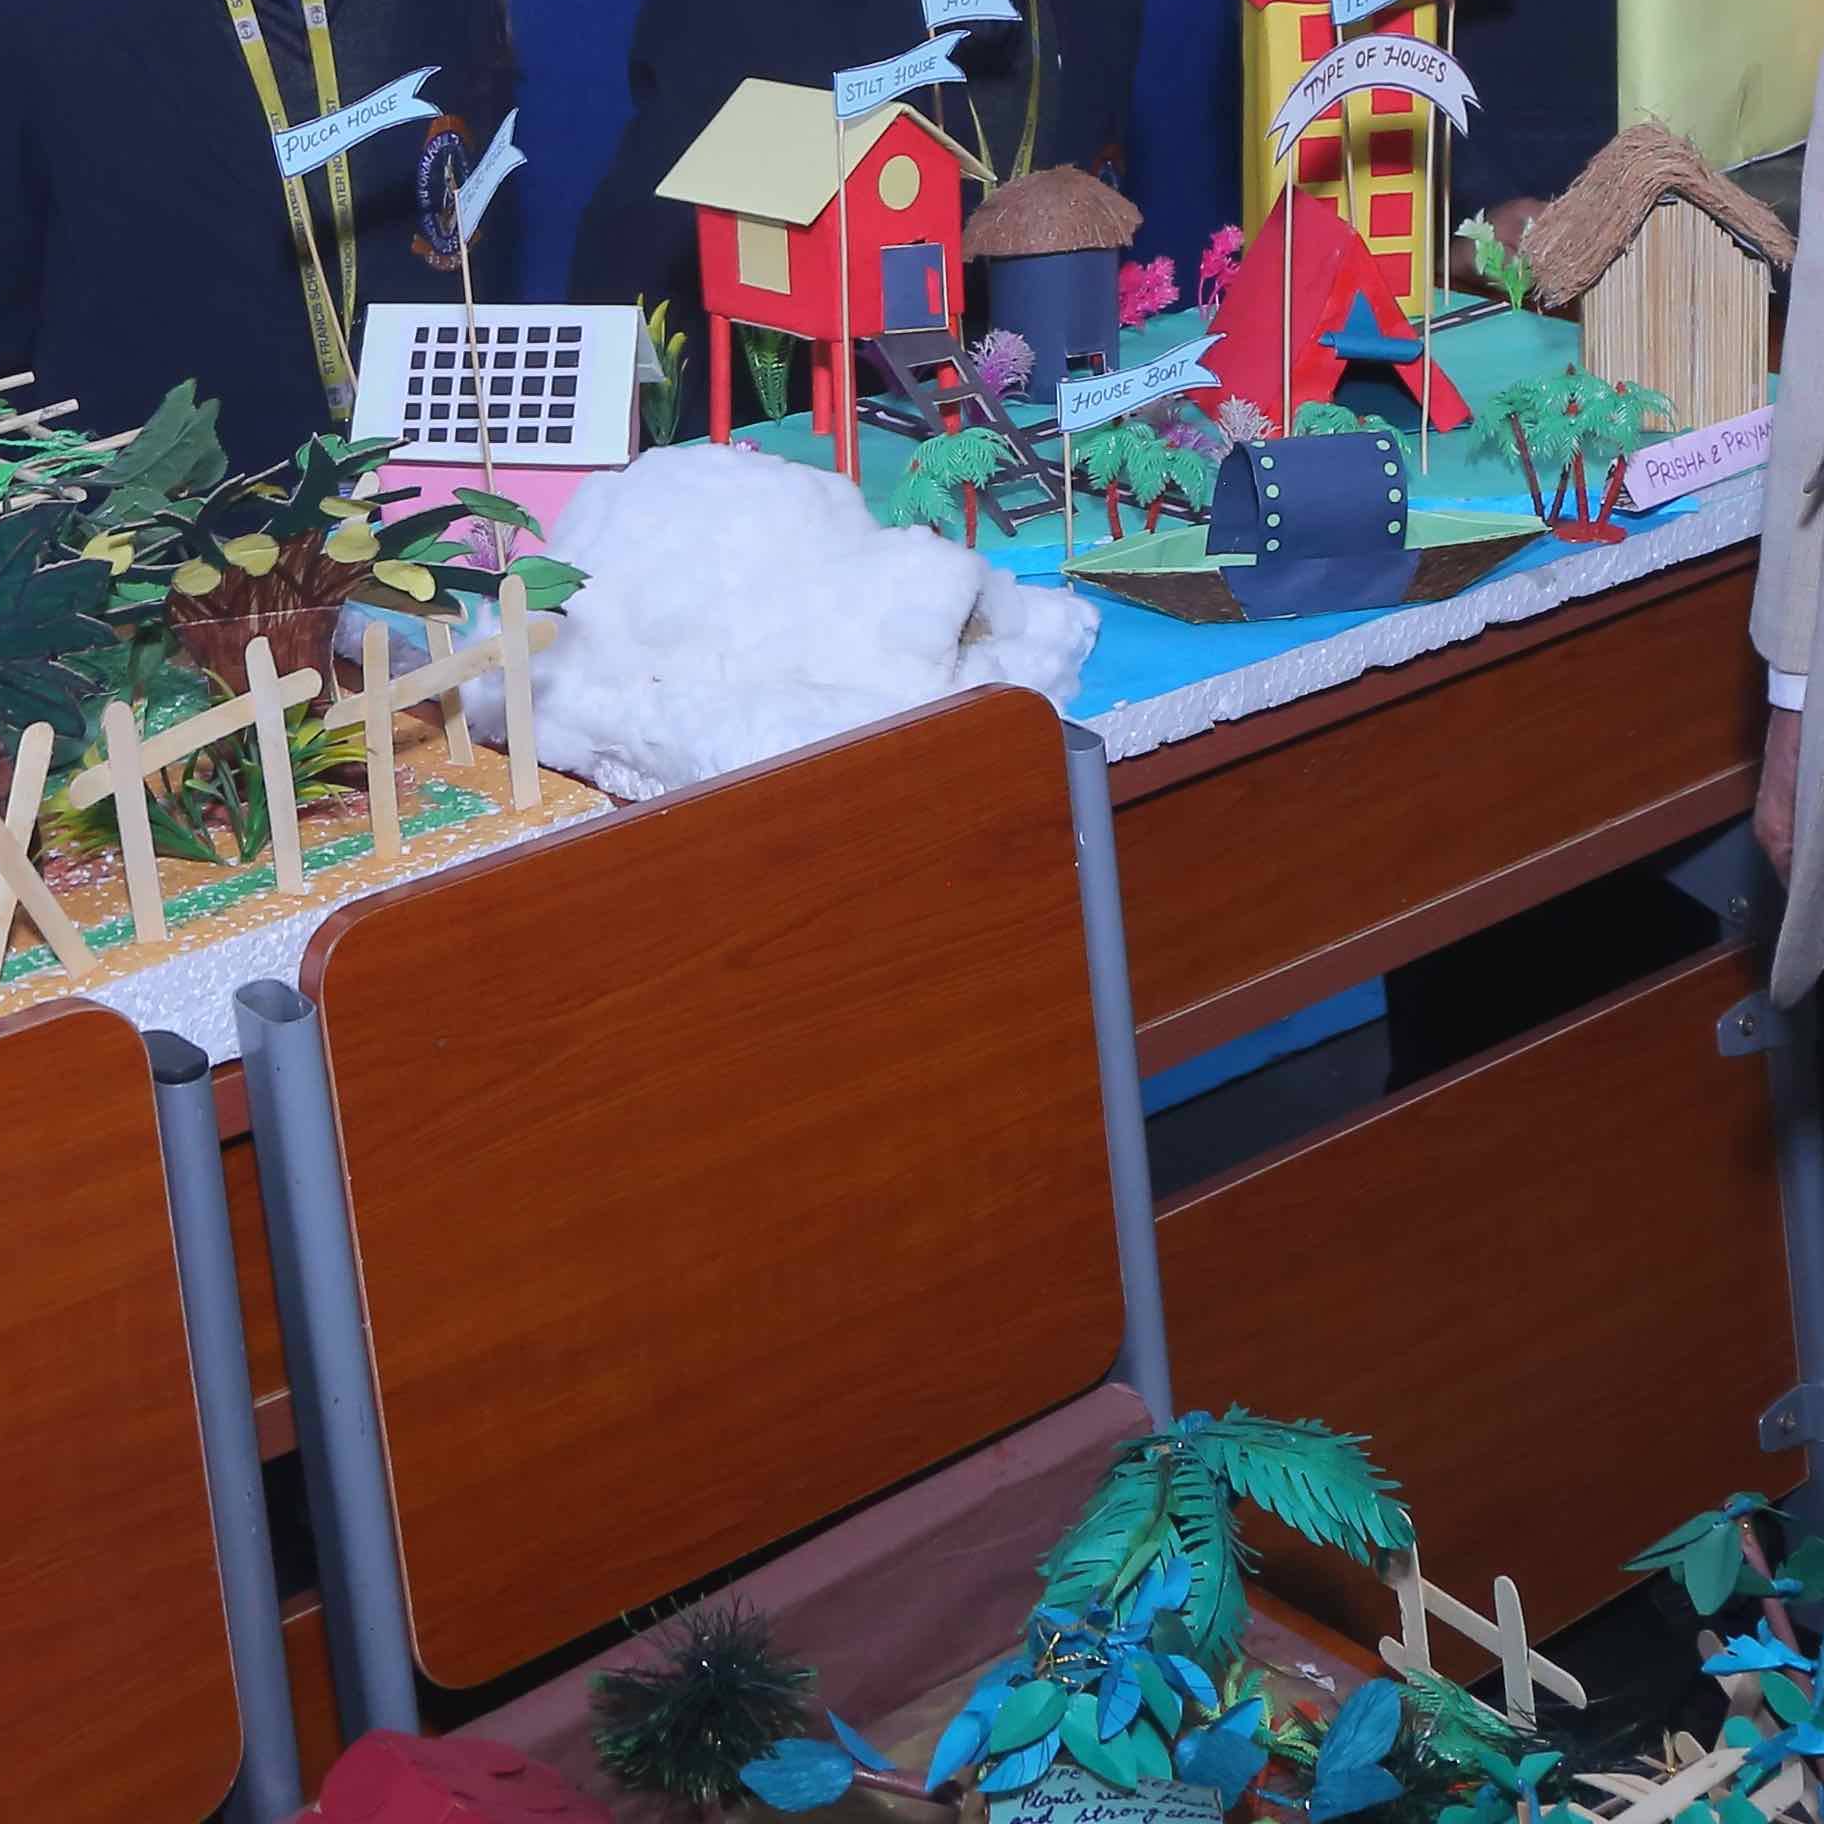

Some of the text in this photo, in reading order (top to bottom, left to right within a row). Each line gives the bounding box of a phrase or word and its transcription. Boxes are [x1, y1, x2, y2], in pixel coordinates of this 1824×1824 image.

[845, 55, 939, 102] STILT HOUSE
[1303, 45, 1448, 105] TYPE OF HOUSES
[281, 122, 341, 162] PUCCA
[346, 93, 399, 128] HOUSE
[1071, 359, 1190, 415] HOUSE BOAT
[1645, 450, 1707, 489] PRISHA
